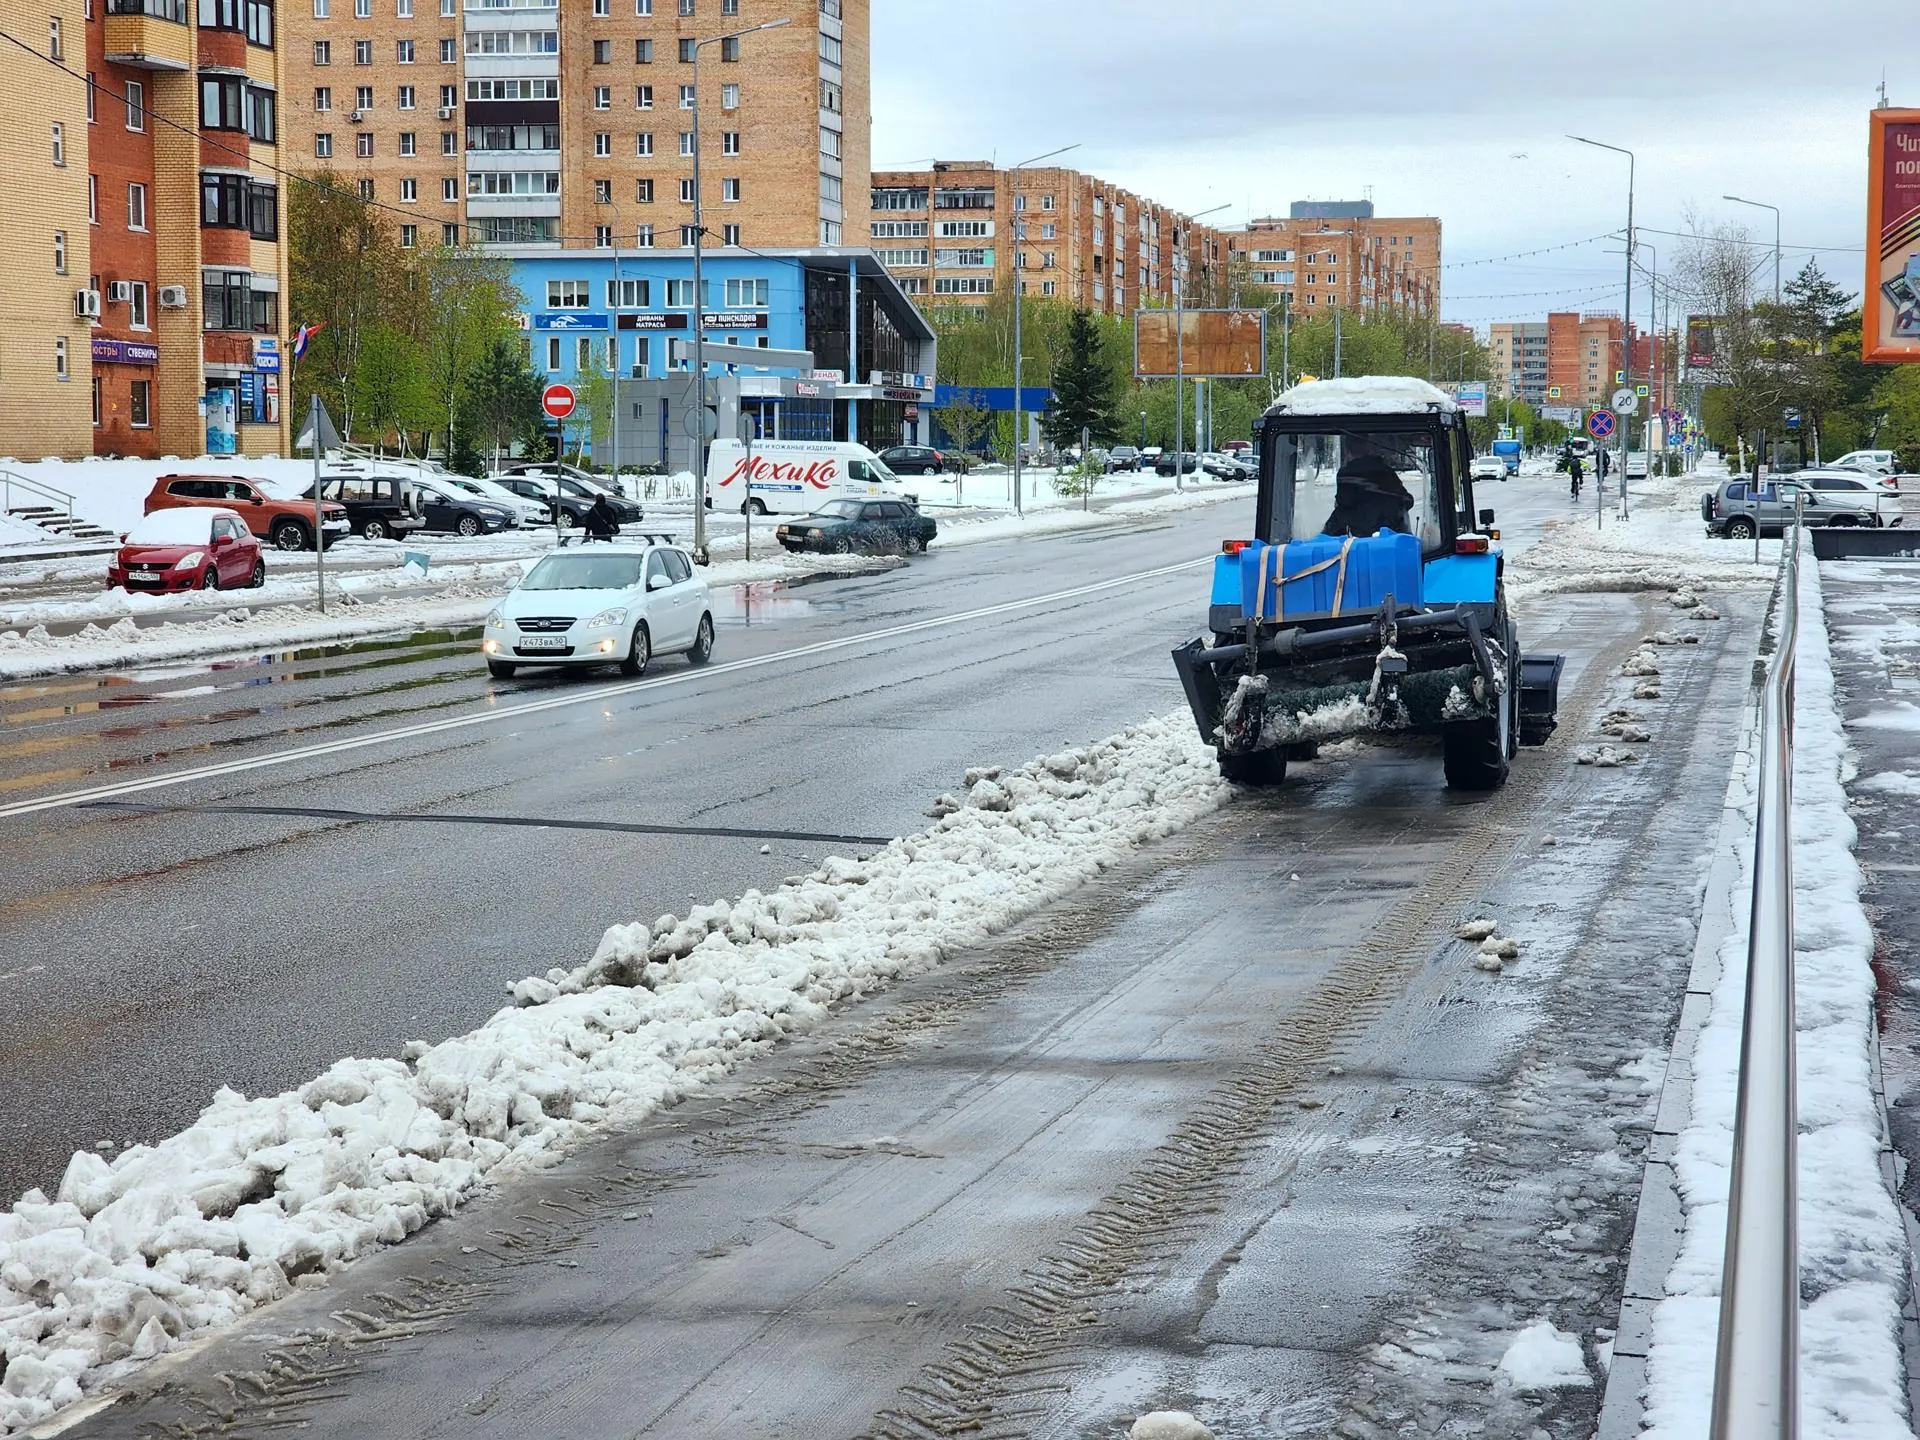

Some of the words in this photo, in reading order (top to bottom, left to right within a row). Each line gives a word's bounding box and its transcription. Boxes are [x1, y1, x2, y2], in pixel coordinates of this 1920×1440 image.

[550, 320, 569, 329] ВСК
[636, 321, 667, 329] МАТРАСЫ
[128, 347, 158, 359] СУВЕНИРЫ
[1618, 396, 1632, 406] 20
[772, 443, 804, 451] КОЖАНЫЕ
